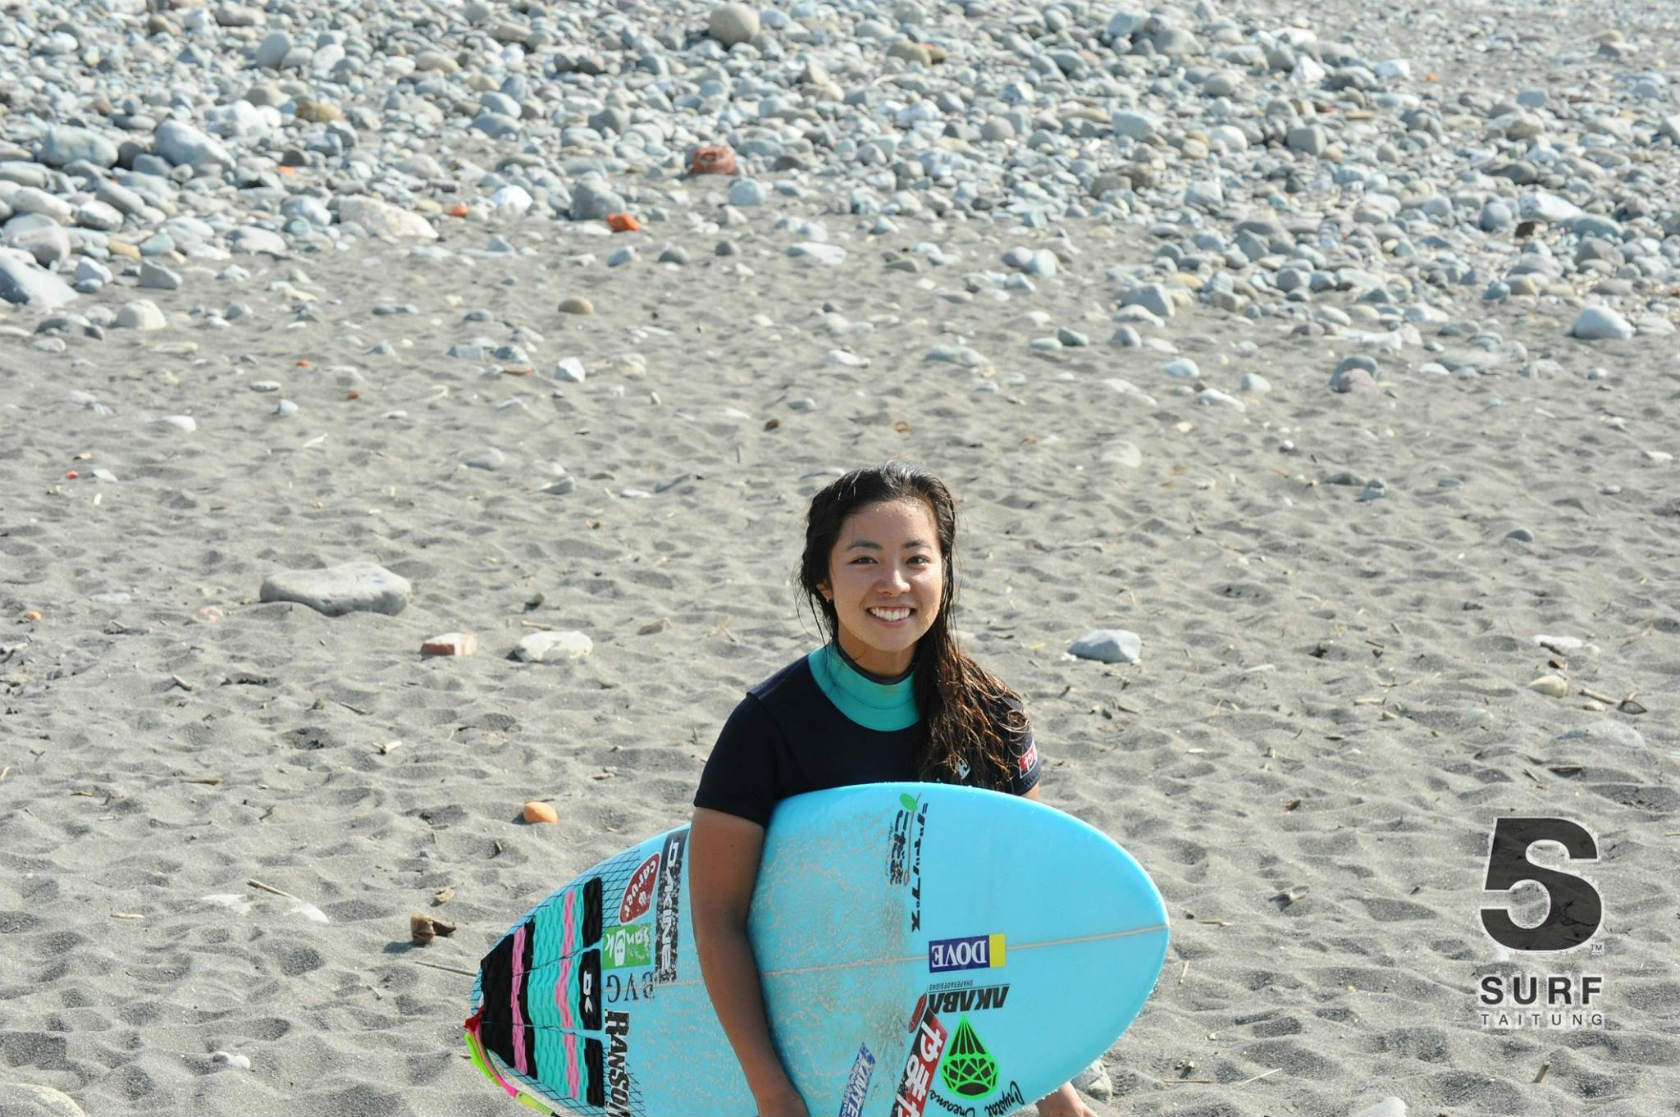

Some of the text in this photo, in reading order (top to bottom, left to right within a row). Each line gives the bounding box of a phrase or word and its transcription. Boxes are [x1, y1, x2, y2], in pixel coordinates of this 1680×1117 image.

[661, 839, 680, 974] DAKINE
[931, 940, 987, 968] DOVE
[928, 985, 1010, 1014] AKABA
